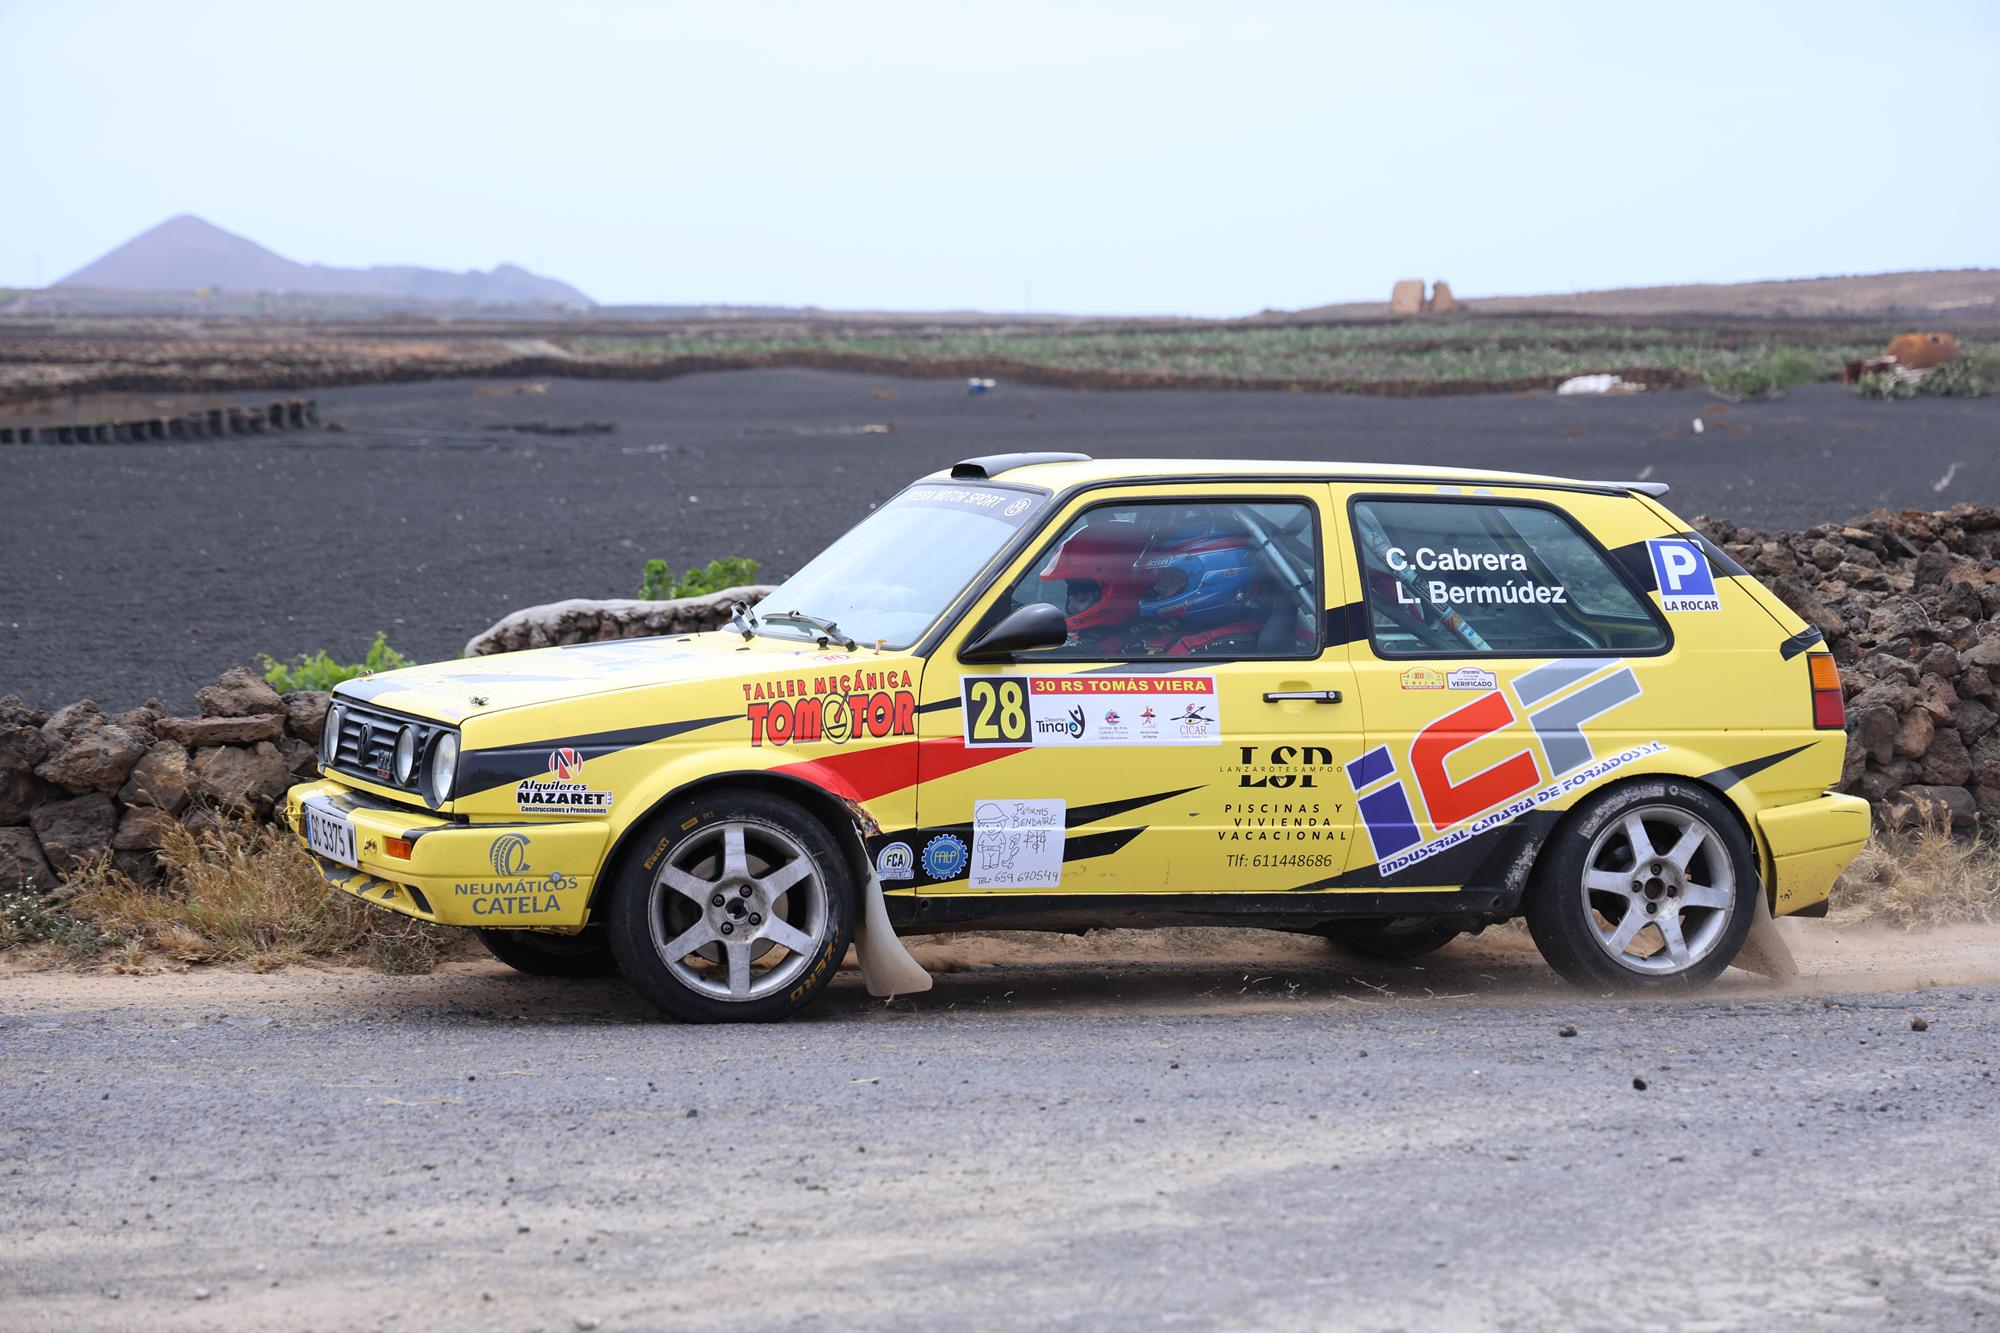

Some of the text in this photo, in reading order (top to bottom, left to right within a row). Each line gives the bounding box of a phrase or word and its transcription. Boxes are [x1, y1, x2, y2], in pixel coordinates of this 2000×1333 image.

[965, 491, 1005, 508] SPORT
[1386, 547, 1528, 571] C.Cabrera
[1659, 546, 1697, 590] P
[1395, 580, 1567, 604] L. Bermúdez
[1664, 600, 1719, 611] LA ROCAR
[743, 669, 912, 700] TALLER MECÁNICA
[1035, 678, 1207, 692] 30 RS TOMÁS VIERA
[747, 690, 916, 747] TOMOTOR
[971, 681, 1026, 740] 28
[1179, 725, 1207, 735] CICAR
[1238, 746, 1333, 788] LSP
[519, 780, 588, 792] Alquileres
[517, 792, 605, 805] NAZARET
[570, 806, 607, 814] Promociones
[1224, 804, 1343, 813] PISCINAS Y
[1381, 830, 1469, 874] INDUSTRIAL
[1471, 798, 1536, 833] CANARIA
[1537, 786, 1560, 802] DE
[1562, 751, 1641, 791] FORJADOS
[1234, 818, 1331, 827] VIVIENDA
[311, 814, 322, 847] GC
[322, 818, 346, 857] 5375
[1218, 832, 1346, 840] VACACIONAL
[886, 853, 904, 868] FCA
[1226, 854, 1333, 867] Tlf: 611448686
[994, 871, 1014, 883] 659
[1017, 869, 1059, 882] 670549
[454, 877, 578, 895] NEUMÁTICOS
[472, 894, 561, 915] CATELA
